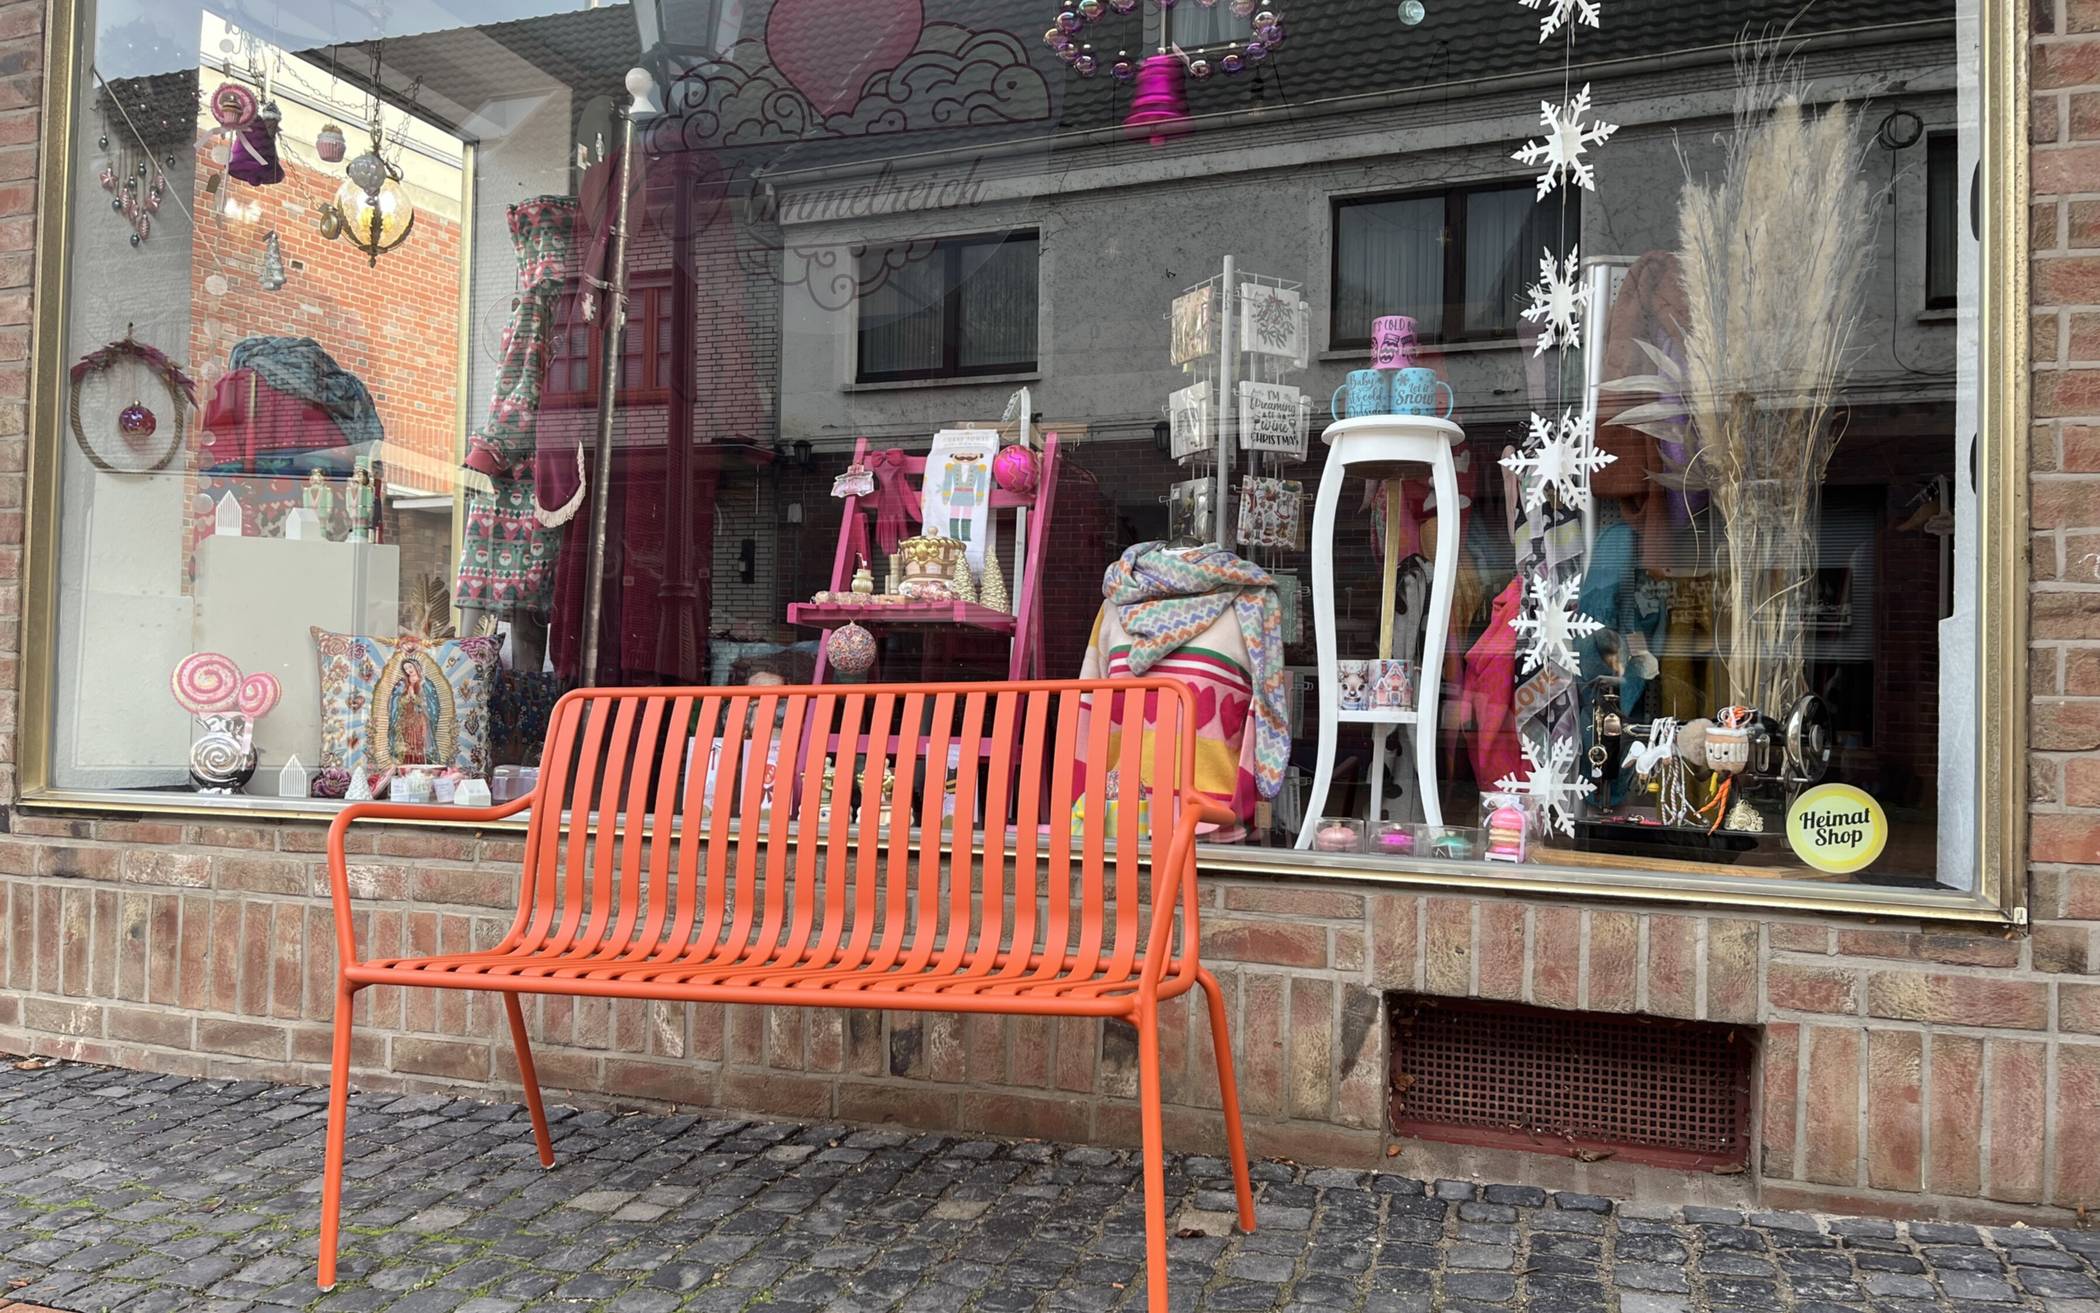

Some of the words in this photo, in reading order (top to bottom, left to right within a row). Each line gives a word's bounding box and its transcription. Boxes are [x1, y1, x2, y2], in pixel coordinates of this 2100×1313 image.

[1384, 318, 1406, 331] COLD
[1395, 389, 1434, 406] Snow
[1799, 807, 1871, 830] Heimat
[1815, 828, 1863, 848] Shop
